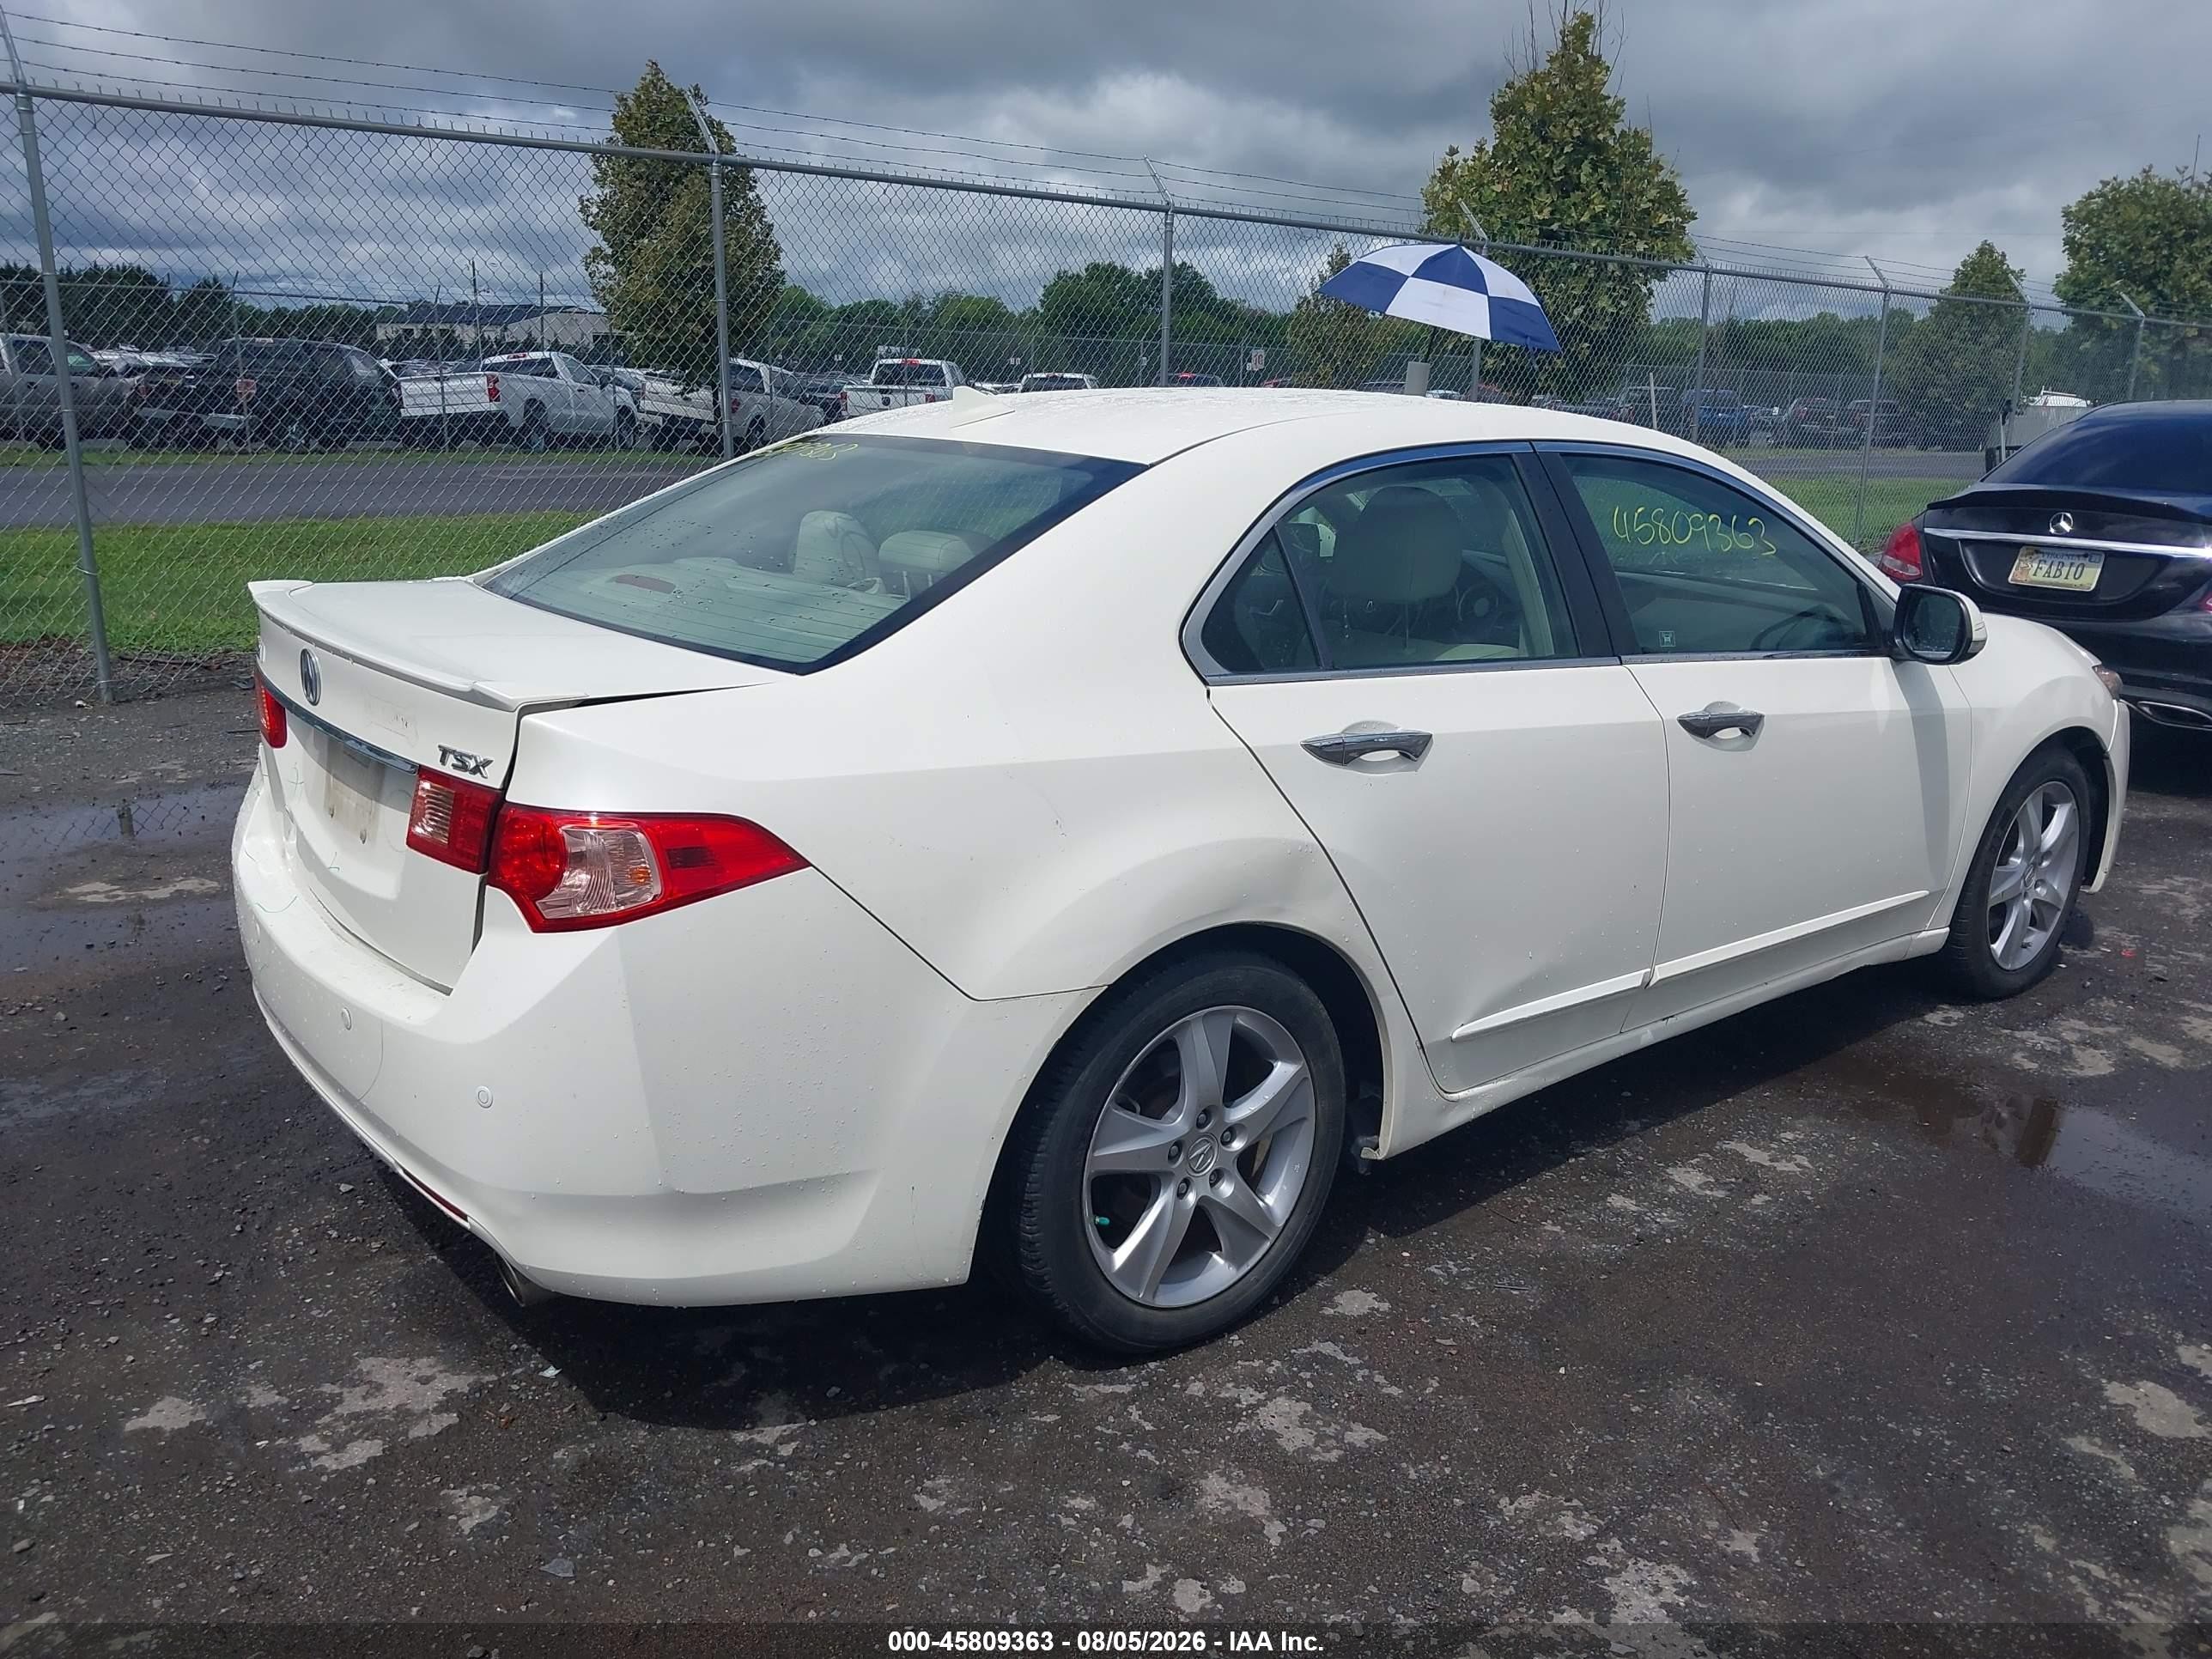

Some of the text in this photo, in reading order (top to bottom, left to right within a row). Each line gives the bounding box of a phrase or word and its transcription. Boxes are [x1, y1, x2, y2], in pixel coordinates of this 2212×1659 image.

[1613, 505, 1777, 556] 45809363
[2032, 559, 2086, 580] FABIO
[437, 744, 495, 780] TSX
